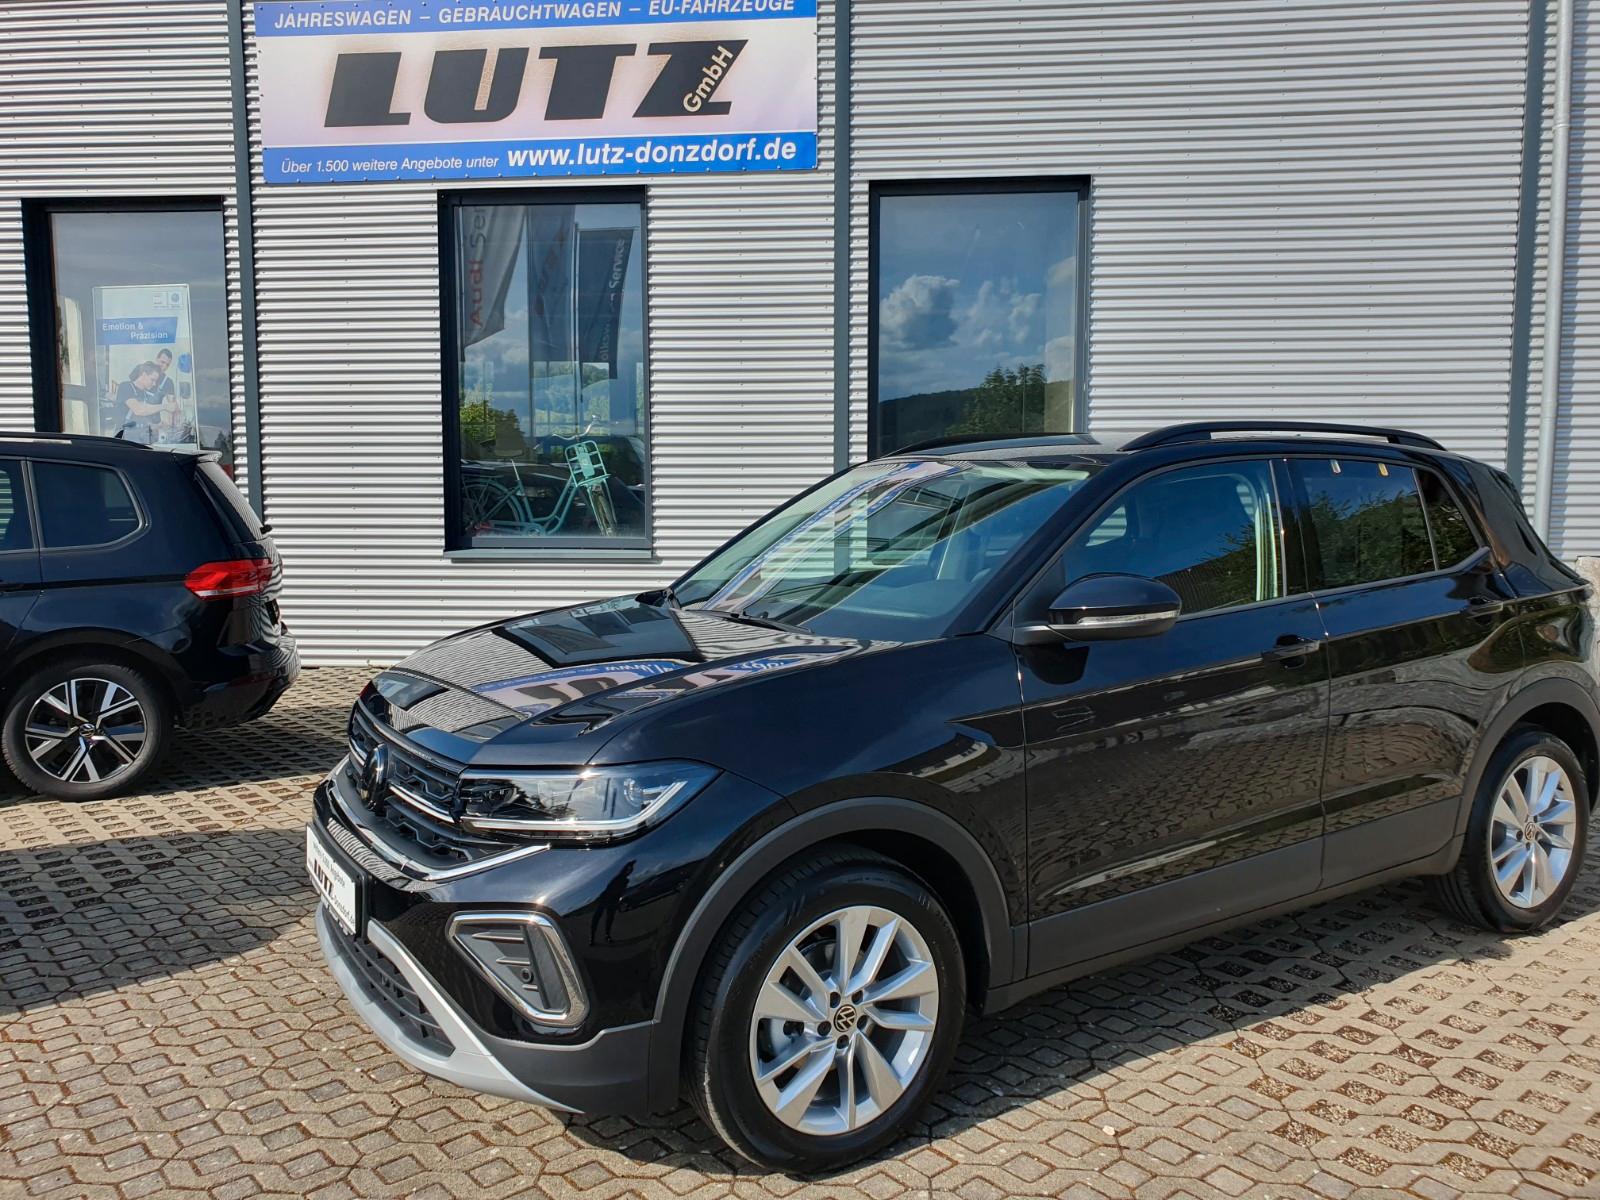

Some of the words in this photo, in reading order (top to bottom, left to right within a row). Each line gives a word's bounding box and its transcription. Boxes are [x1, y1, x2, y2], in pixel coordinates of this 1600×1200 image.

[274, 9, 412, 29] JAHRESWAGEN
[438, 2, 621, 25] GEBRAUCHTWAGEN
[648, 0, 795, 16] EU-FAHRZEUGE
[324, 39, 749, 128] LUTZ
[682, 45, 733, 113] GmbH
[281, 158, 311, 174] Über
[316, 159, 349, 173] 1.500
[352, 158, 398, 171] weitere
[401, 156, 463, 173] Angebote
[466, 157, 500, 168] unter
[507, 137, 798, 167] www.lutz-donzdorf.de
[609, 238, 626, 289] Service
[469, 258, 484, 326] Audi
[102, 322, 136, 331] Emotion
[138, 321, 144, 330] &
[130, 330, 168, 340] Präzision
